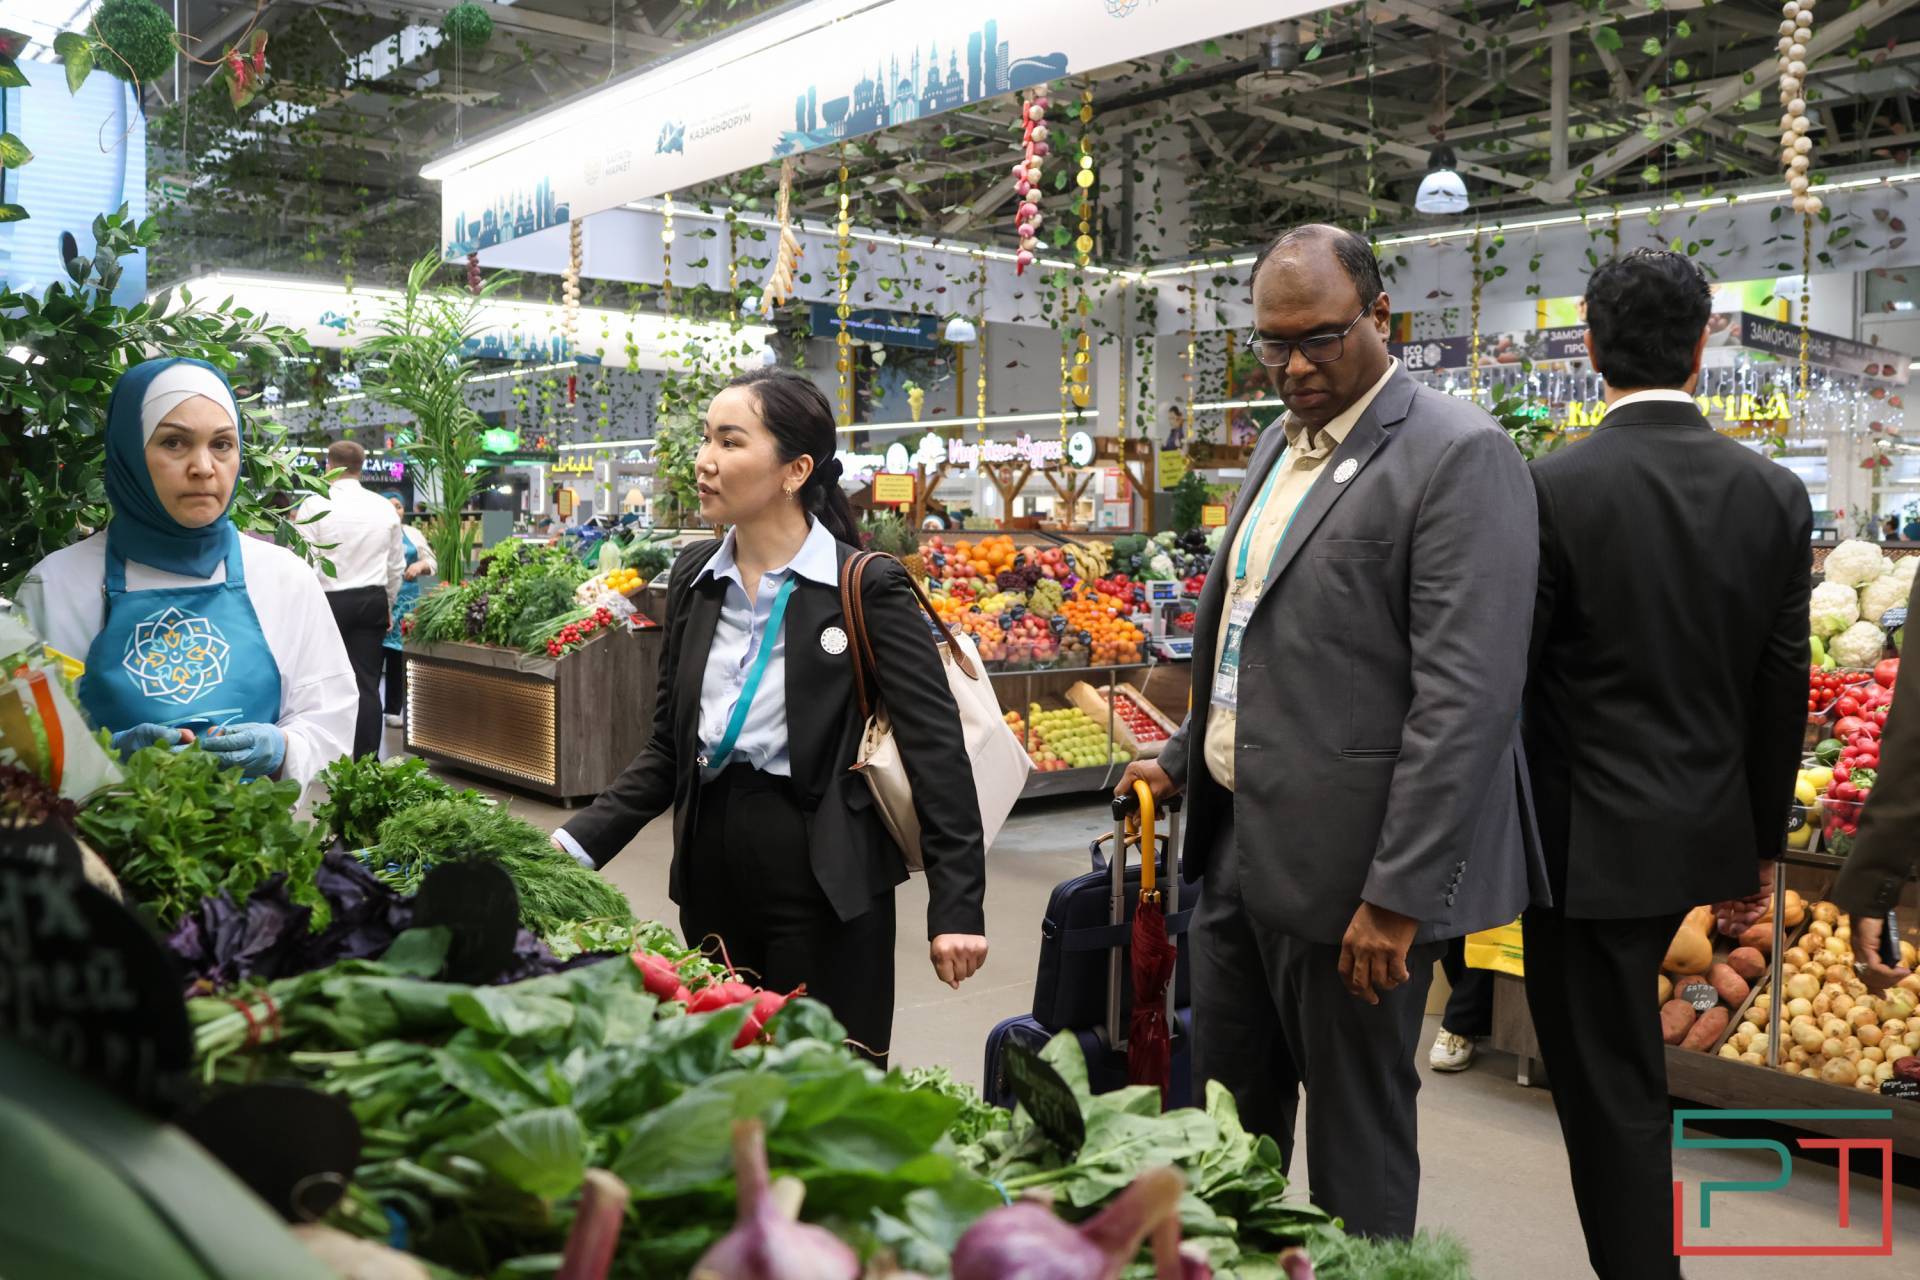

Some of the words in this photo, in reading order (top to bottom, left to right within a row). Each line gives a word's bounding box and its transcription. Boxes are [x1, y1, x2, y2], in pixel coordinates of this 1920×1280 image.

[689, 112, 751, 142] КАЗАНЬФОРУМ
[1403, 344, 1422, 356] ECO
[1750, 321, 1831, 358] ЗАМОРОЖНЫЕ
[1404, 356, 1423, 368] ICE
